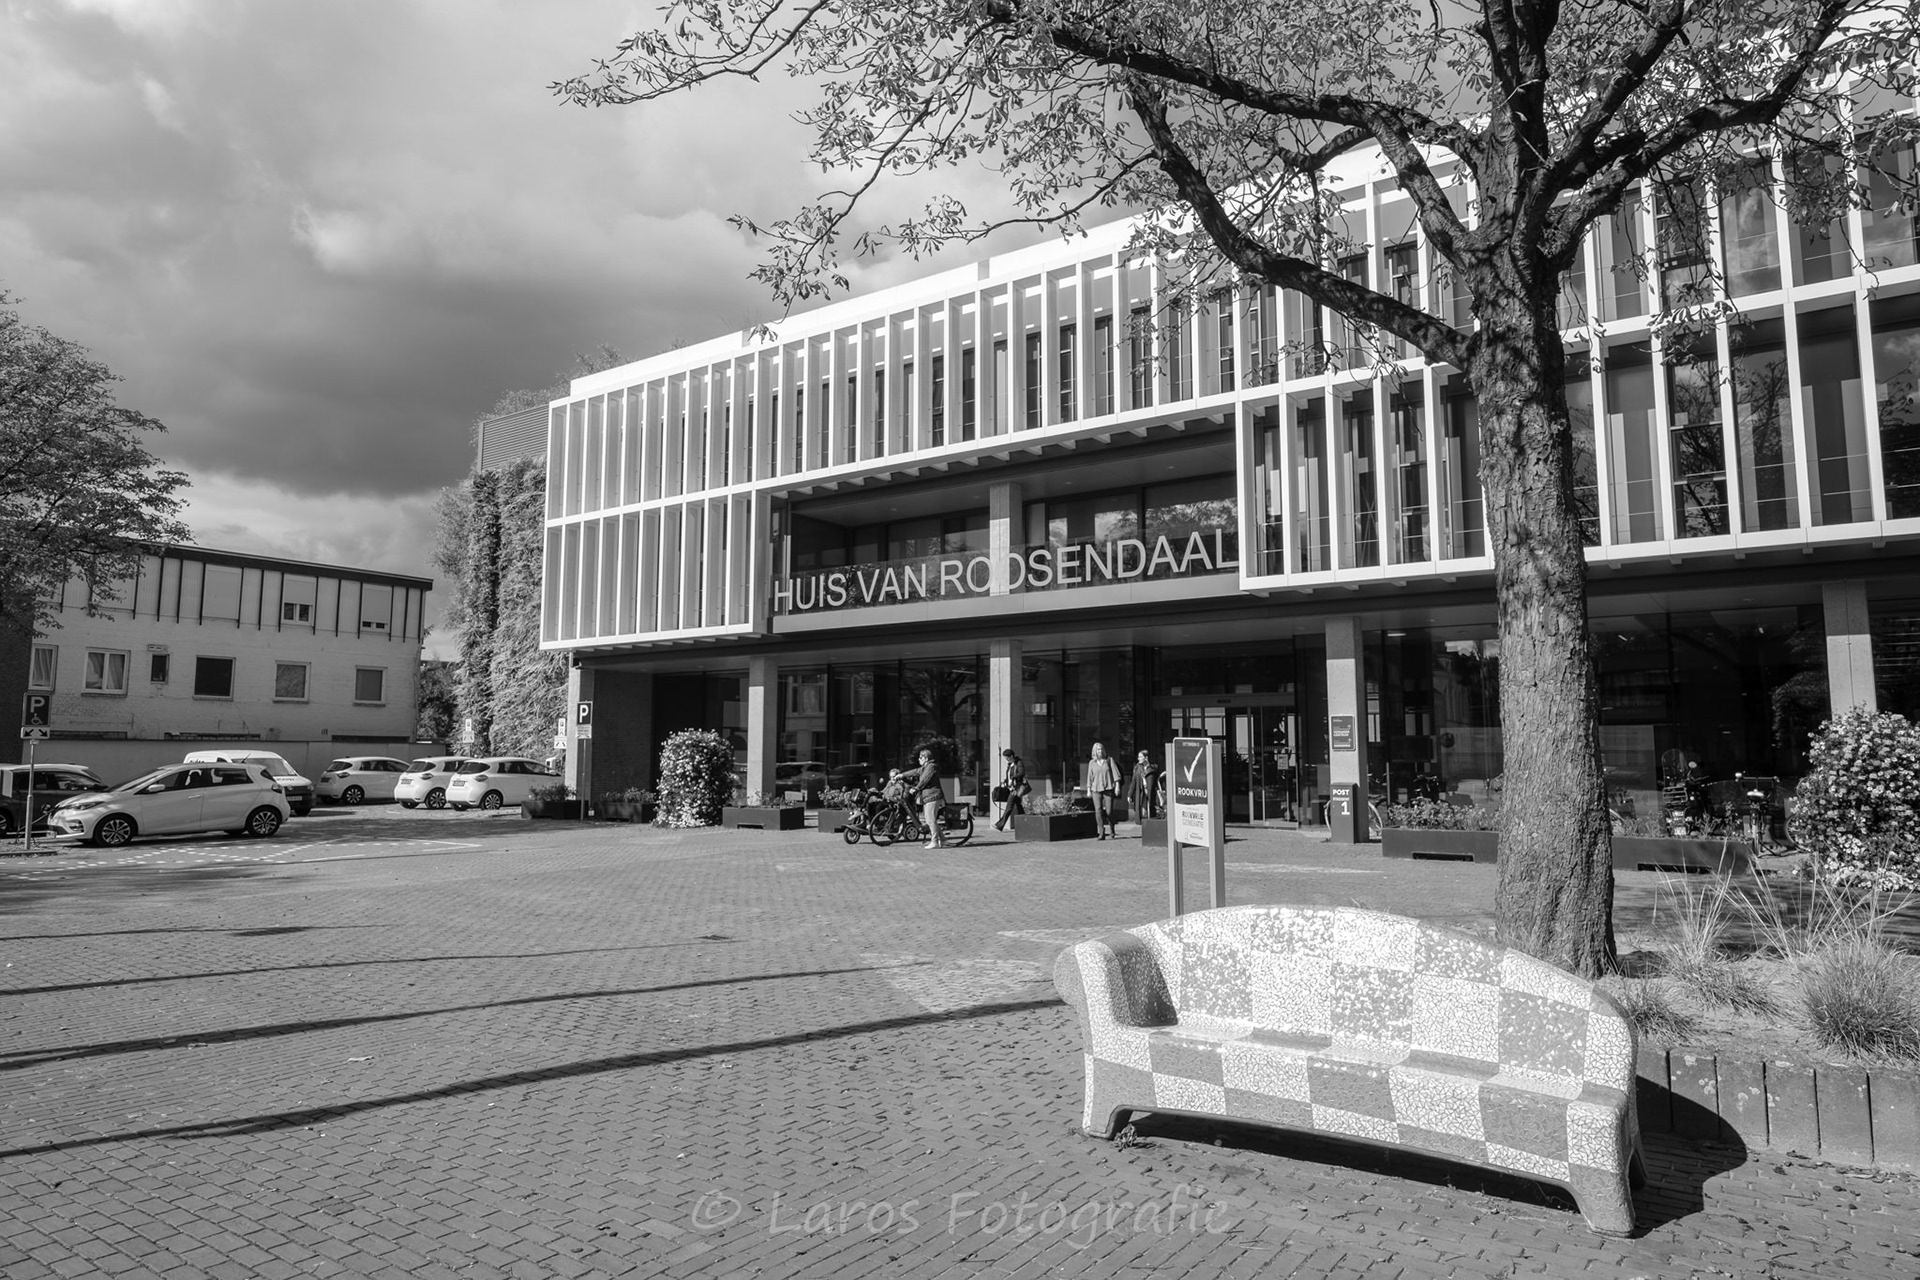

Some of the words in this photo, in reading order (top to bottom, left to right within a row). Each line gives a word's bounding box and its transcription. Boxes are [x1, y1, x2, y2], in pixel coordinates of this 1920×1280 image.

[774, 573, 847, 612] HUIS
[857, 563, 927, 603] VAN
[940, 528, 1239, 596] ROOSENDAAL
[30, 696, 45, 713] P
[579, 704, 589, 723] P
[1177, 787, 1208, 798] ROOKVRIJ
[1341, 801, 1350, 816] 1
